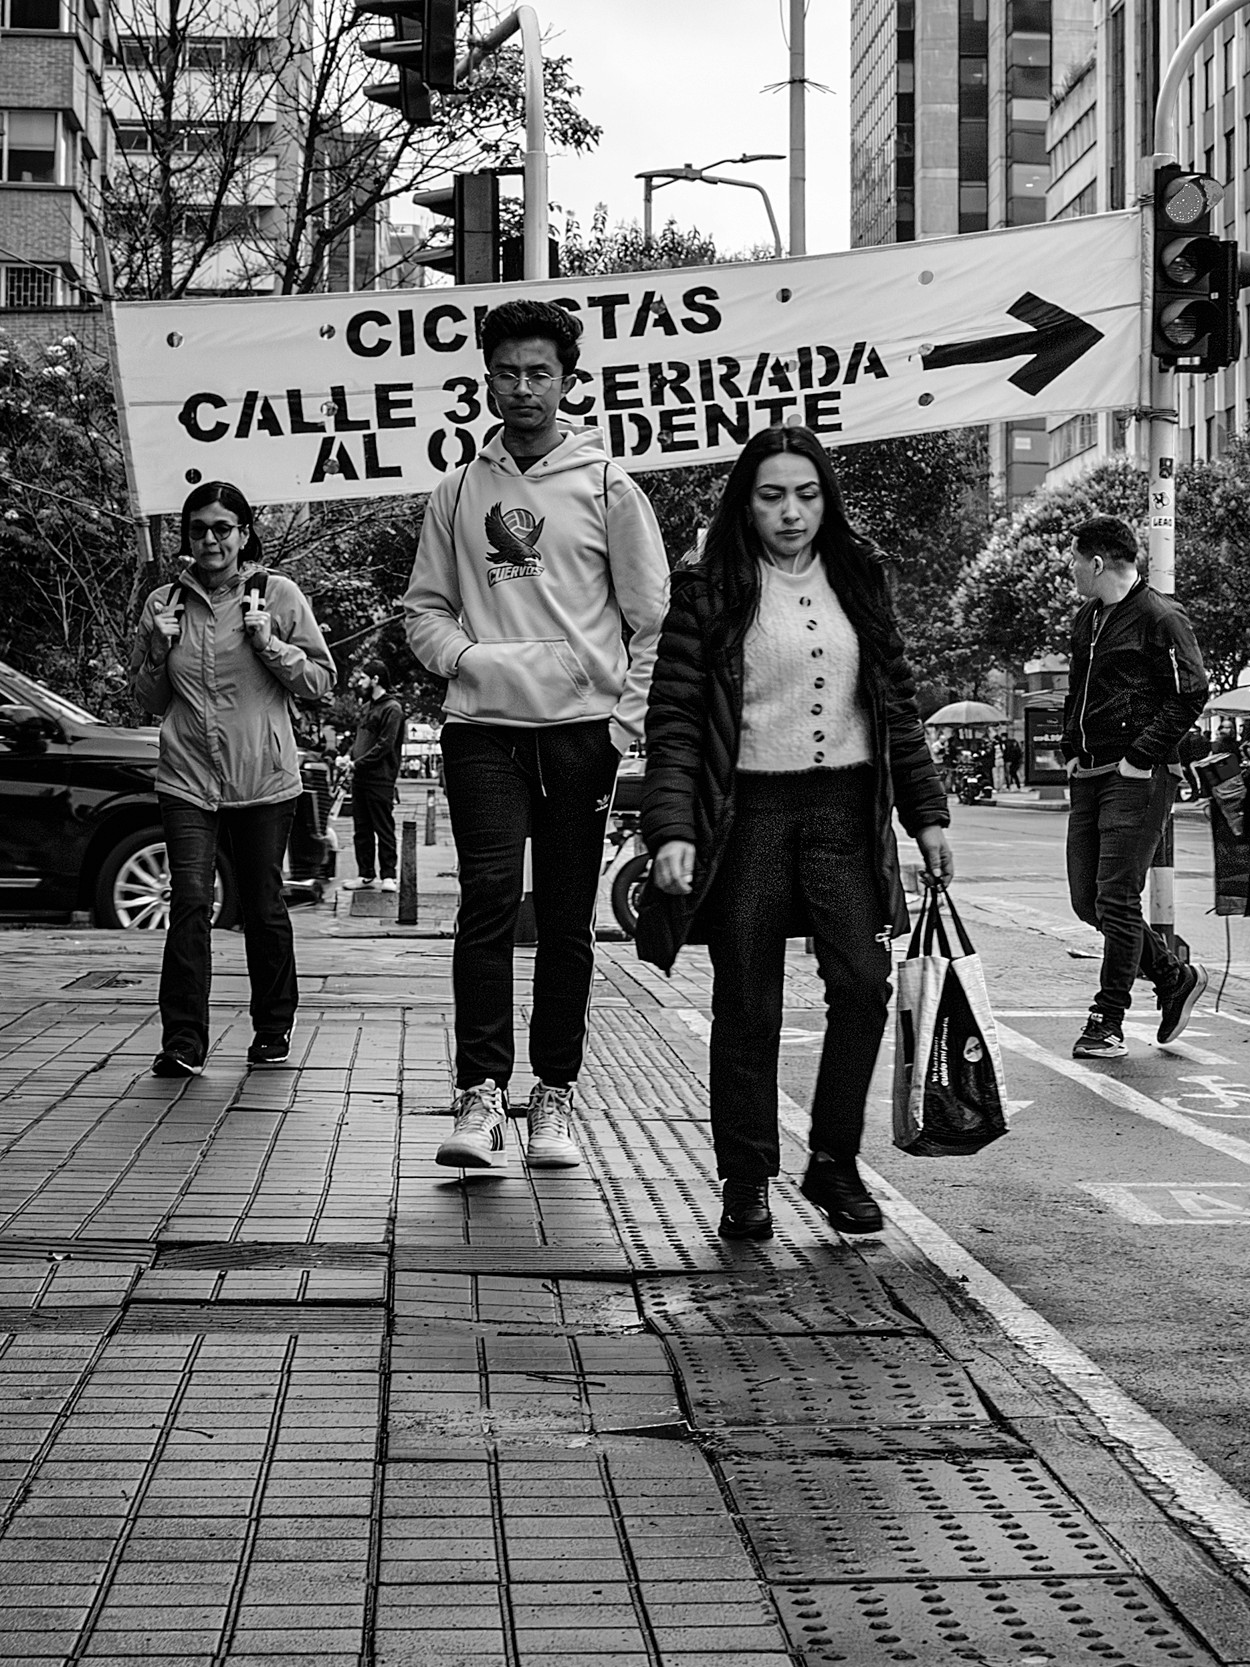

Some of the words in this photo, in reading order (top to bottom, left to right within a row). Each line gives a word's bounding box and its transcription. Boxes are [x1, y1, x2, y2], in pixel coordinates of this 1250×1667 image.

[346, 285, 722, 358] CICTAS
[178, 382, 417, 443] CALLE
[442, 376, 504, 425] 3
[558, 341, 890, 416] CERRADA
[310, 432, 403, 483] AL
[427, 390, 843, 473] ODENTE
[489, 565, 543, 585] CUERVOS
